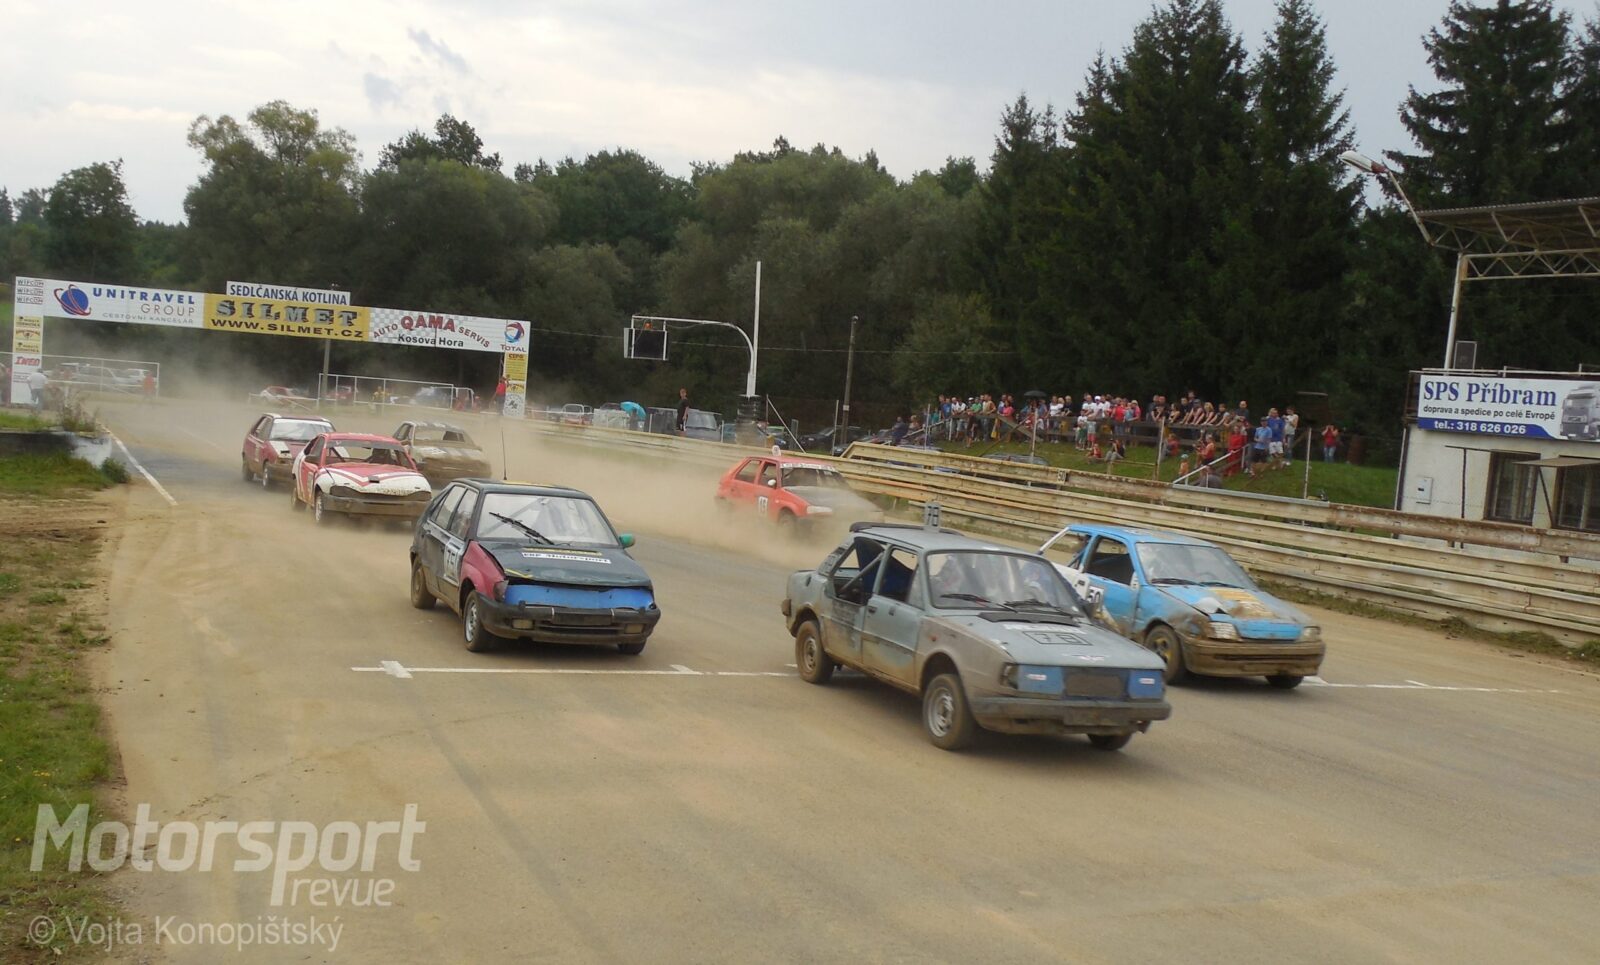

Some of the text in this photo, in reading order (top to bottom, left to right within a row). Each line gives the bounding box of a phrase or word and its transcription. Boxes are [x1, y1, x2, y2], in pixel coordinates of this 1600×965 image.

[93, 287, 195, 304] UNITRAVEL
[230, 284, 347, 305] SEDLČANSKÁ KOTLINA
[141, 303, 195, 316] GROUP
[216, 299, 359, 327] SILMET
[211, 319, 363, 338] WWW.SILMET.CZ
[373, 323, 399, 339] AUTO
[400, 314, 456, 333] QAMA
[398, 334, 464, 348] Kosova Hora
[458, 326, 490, 348] SERVIS
[501, 343, 527, 352] TOTAL
[1423, 380, 1557, 407] SPS Příbram
[1423, 404, 1453, 415] doprava
[1460, 407, 1492, 418] spedice
[1493, 410, 1504, 418] po
[1505, 409, 1523, 418] celé
[1434, 420, 1526, 435] tel.: 318 626 026
